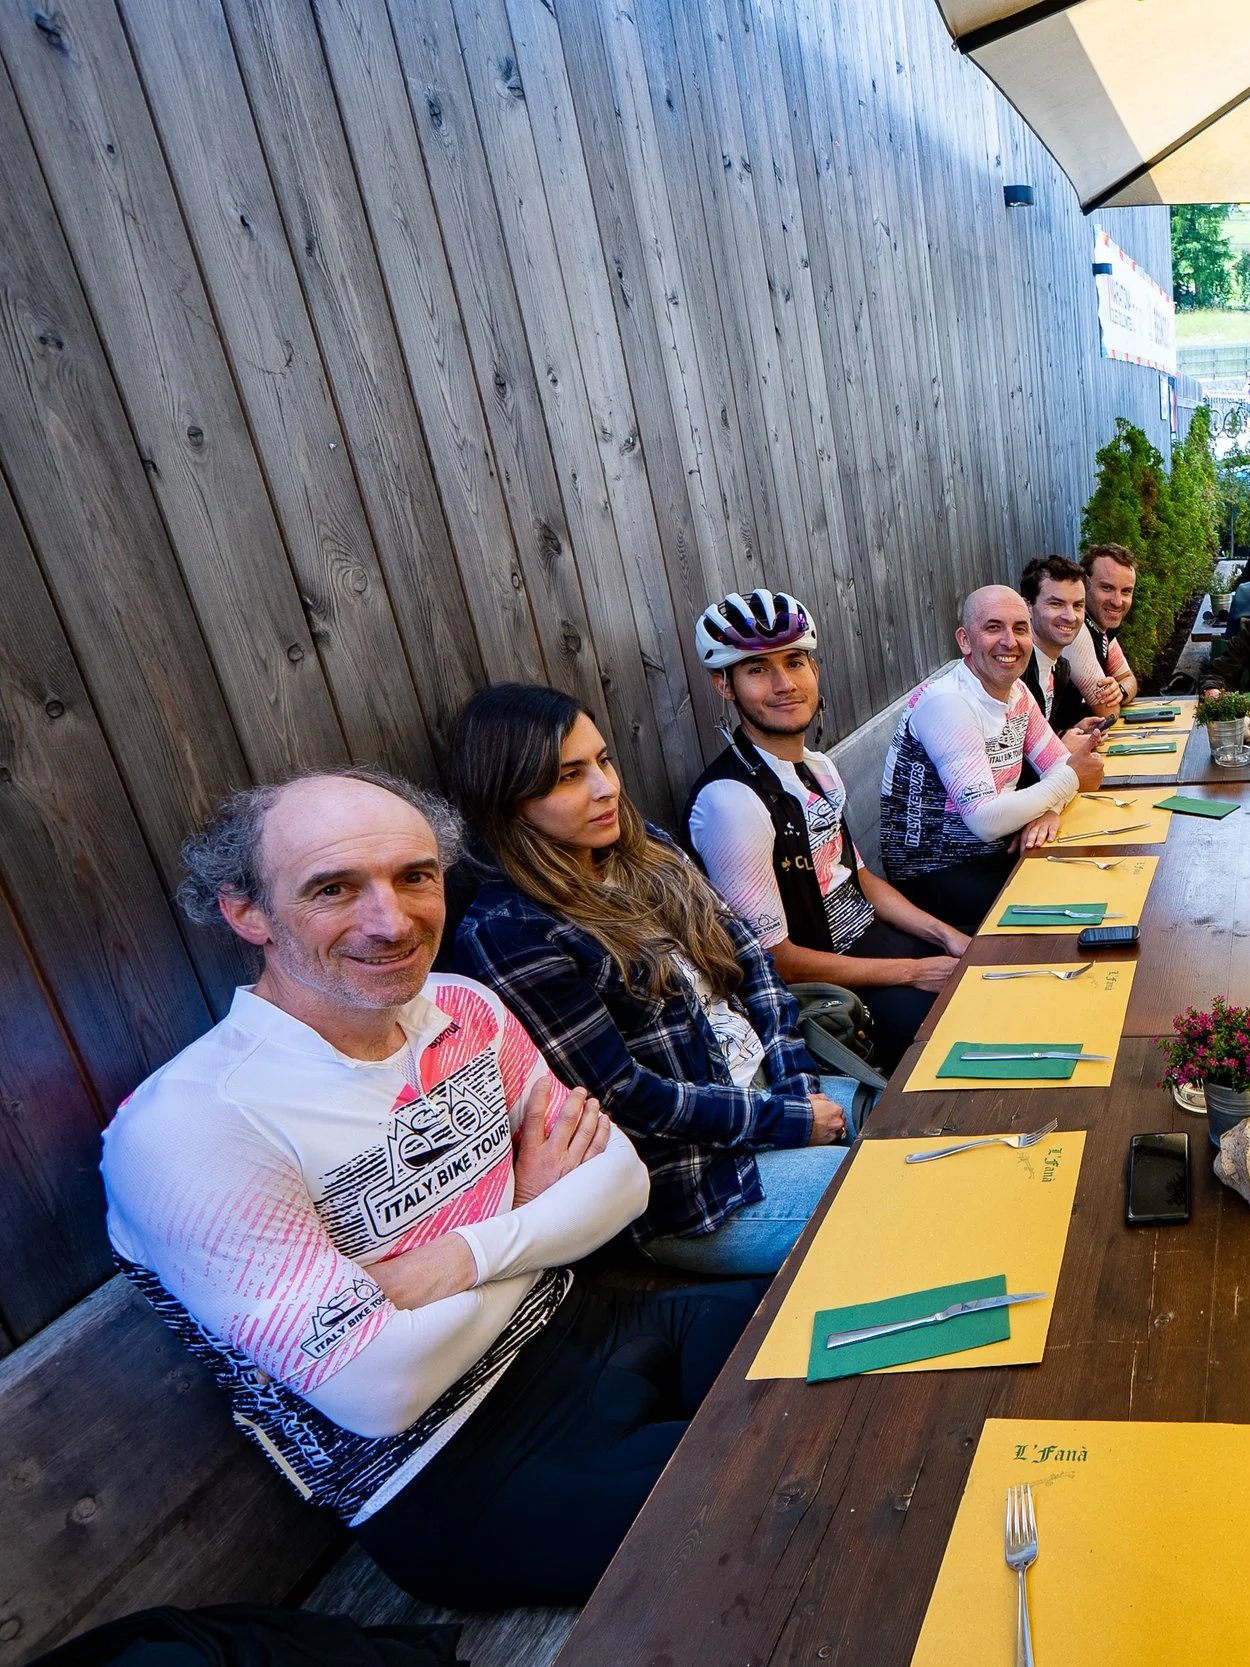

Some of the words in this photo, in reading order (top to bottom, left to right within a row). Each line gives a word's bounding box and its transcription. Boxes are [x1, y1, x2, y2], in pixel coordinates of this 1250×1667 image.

[908, 761, 926, 795] OURS
[906, 796, 922, 818] BKE
[384, 1178, 434, 1224] ITALY
[437, 1151, 471, 1188] BIKE
[314, 1325, 346, 1354] ITALY
[347, 1306, 372, 1328] BIKE
